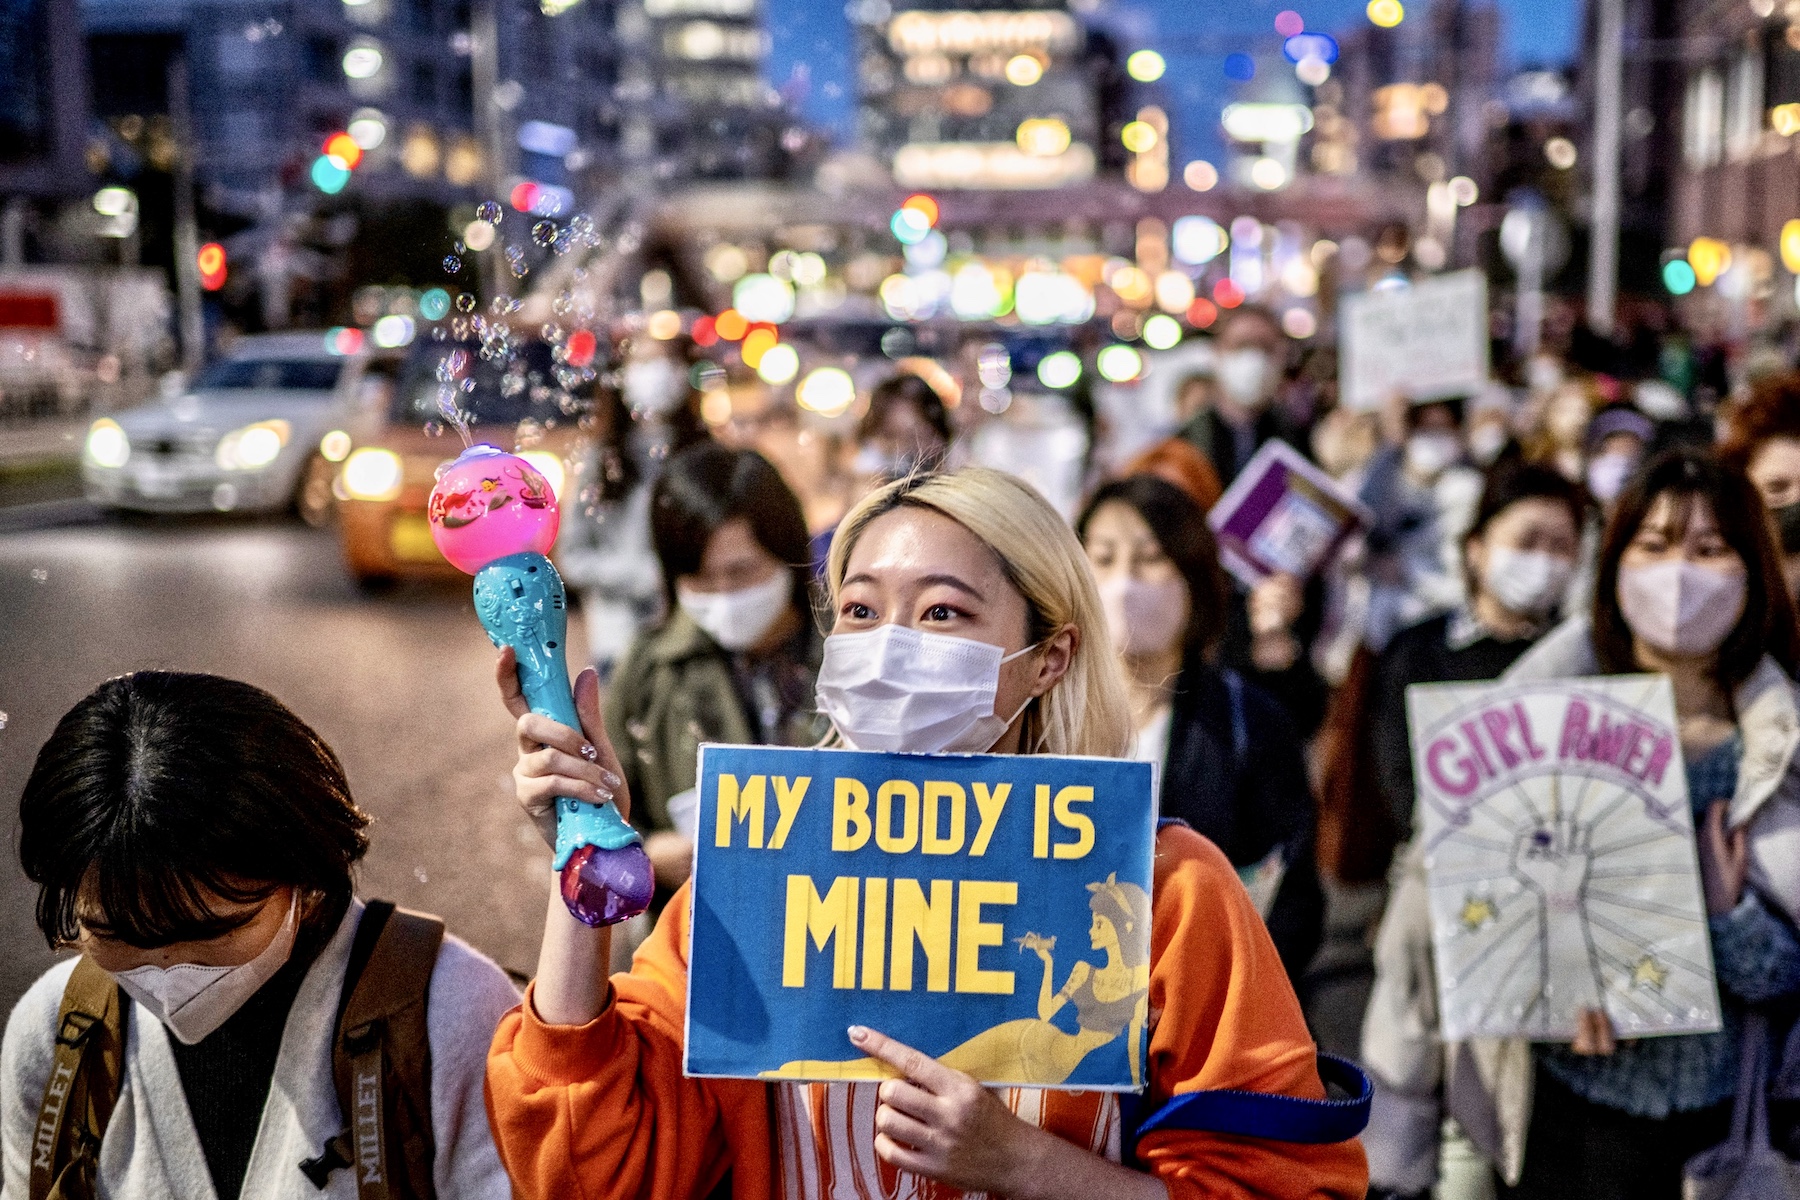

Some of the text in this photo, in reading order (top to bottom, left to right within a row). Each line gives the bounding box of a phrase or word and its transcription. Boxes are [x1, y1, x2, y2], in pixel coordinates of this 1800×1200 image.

[1426, 694, 1673, 797] GIRL POWER
[715, 773, 1096, 860] MY BODY IS
[782, 874, 1019, 995] MINE
[34, 1062, 73, 1171] MILLET
[357, 1073, 381, 1185] MILLET
